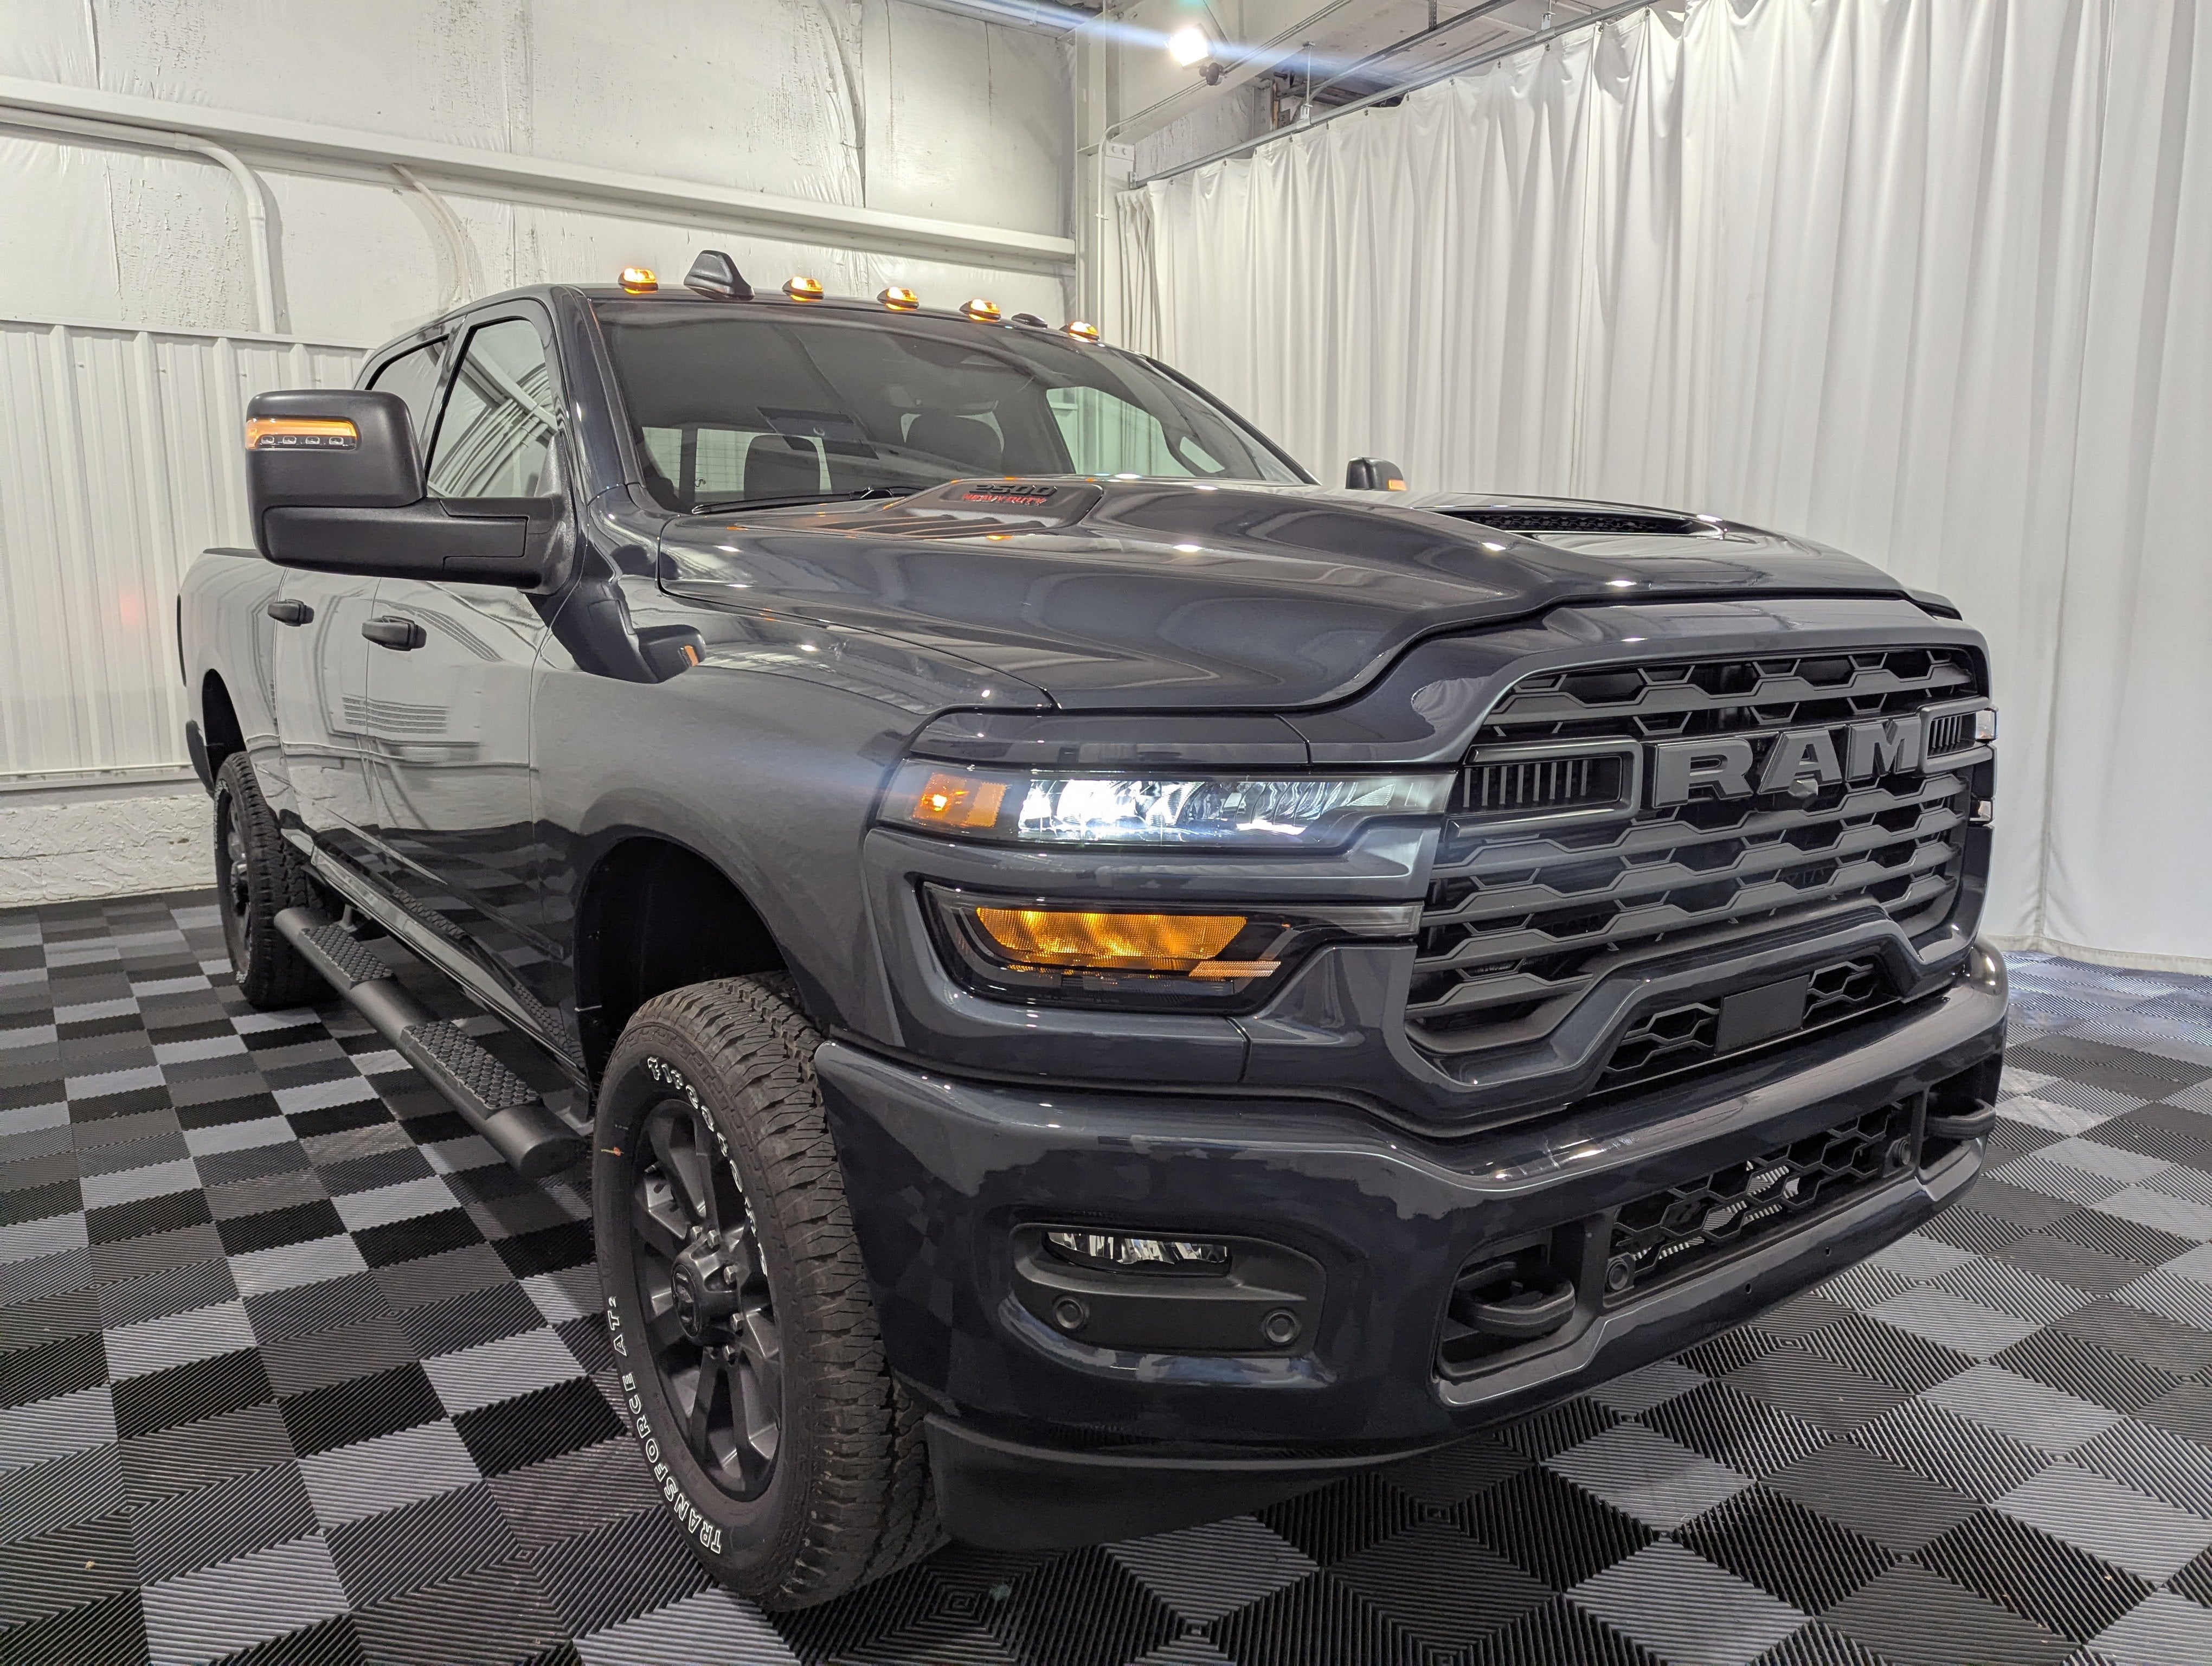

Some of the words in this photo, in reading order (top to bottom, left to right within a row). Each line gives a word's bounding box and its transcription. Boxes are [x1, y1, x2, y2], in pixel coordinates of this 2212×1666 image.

[962, 494, 1006, 503] HEAVY
[1004, 496, 1047, 506] DUTY
[1653, 716, 1922, 809] RAM
[608, 1296, 627, 1356] AT2
[623, 1372, 722, 1554] TRANSFORCE
